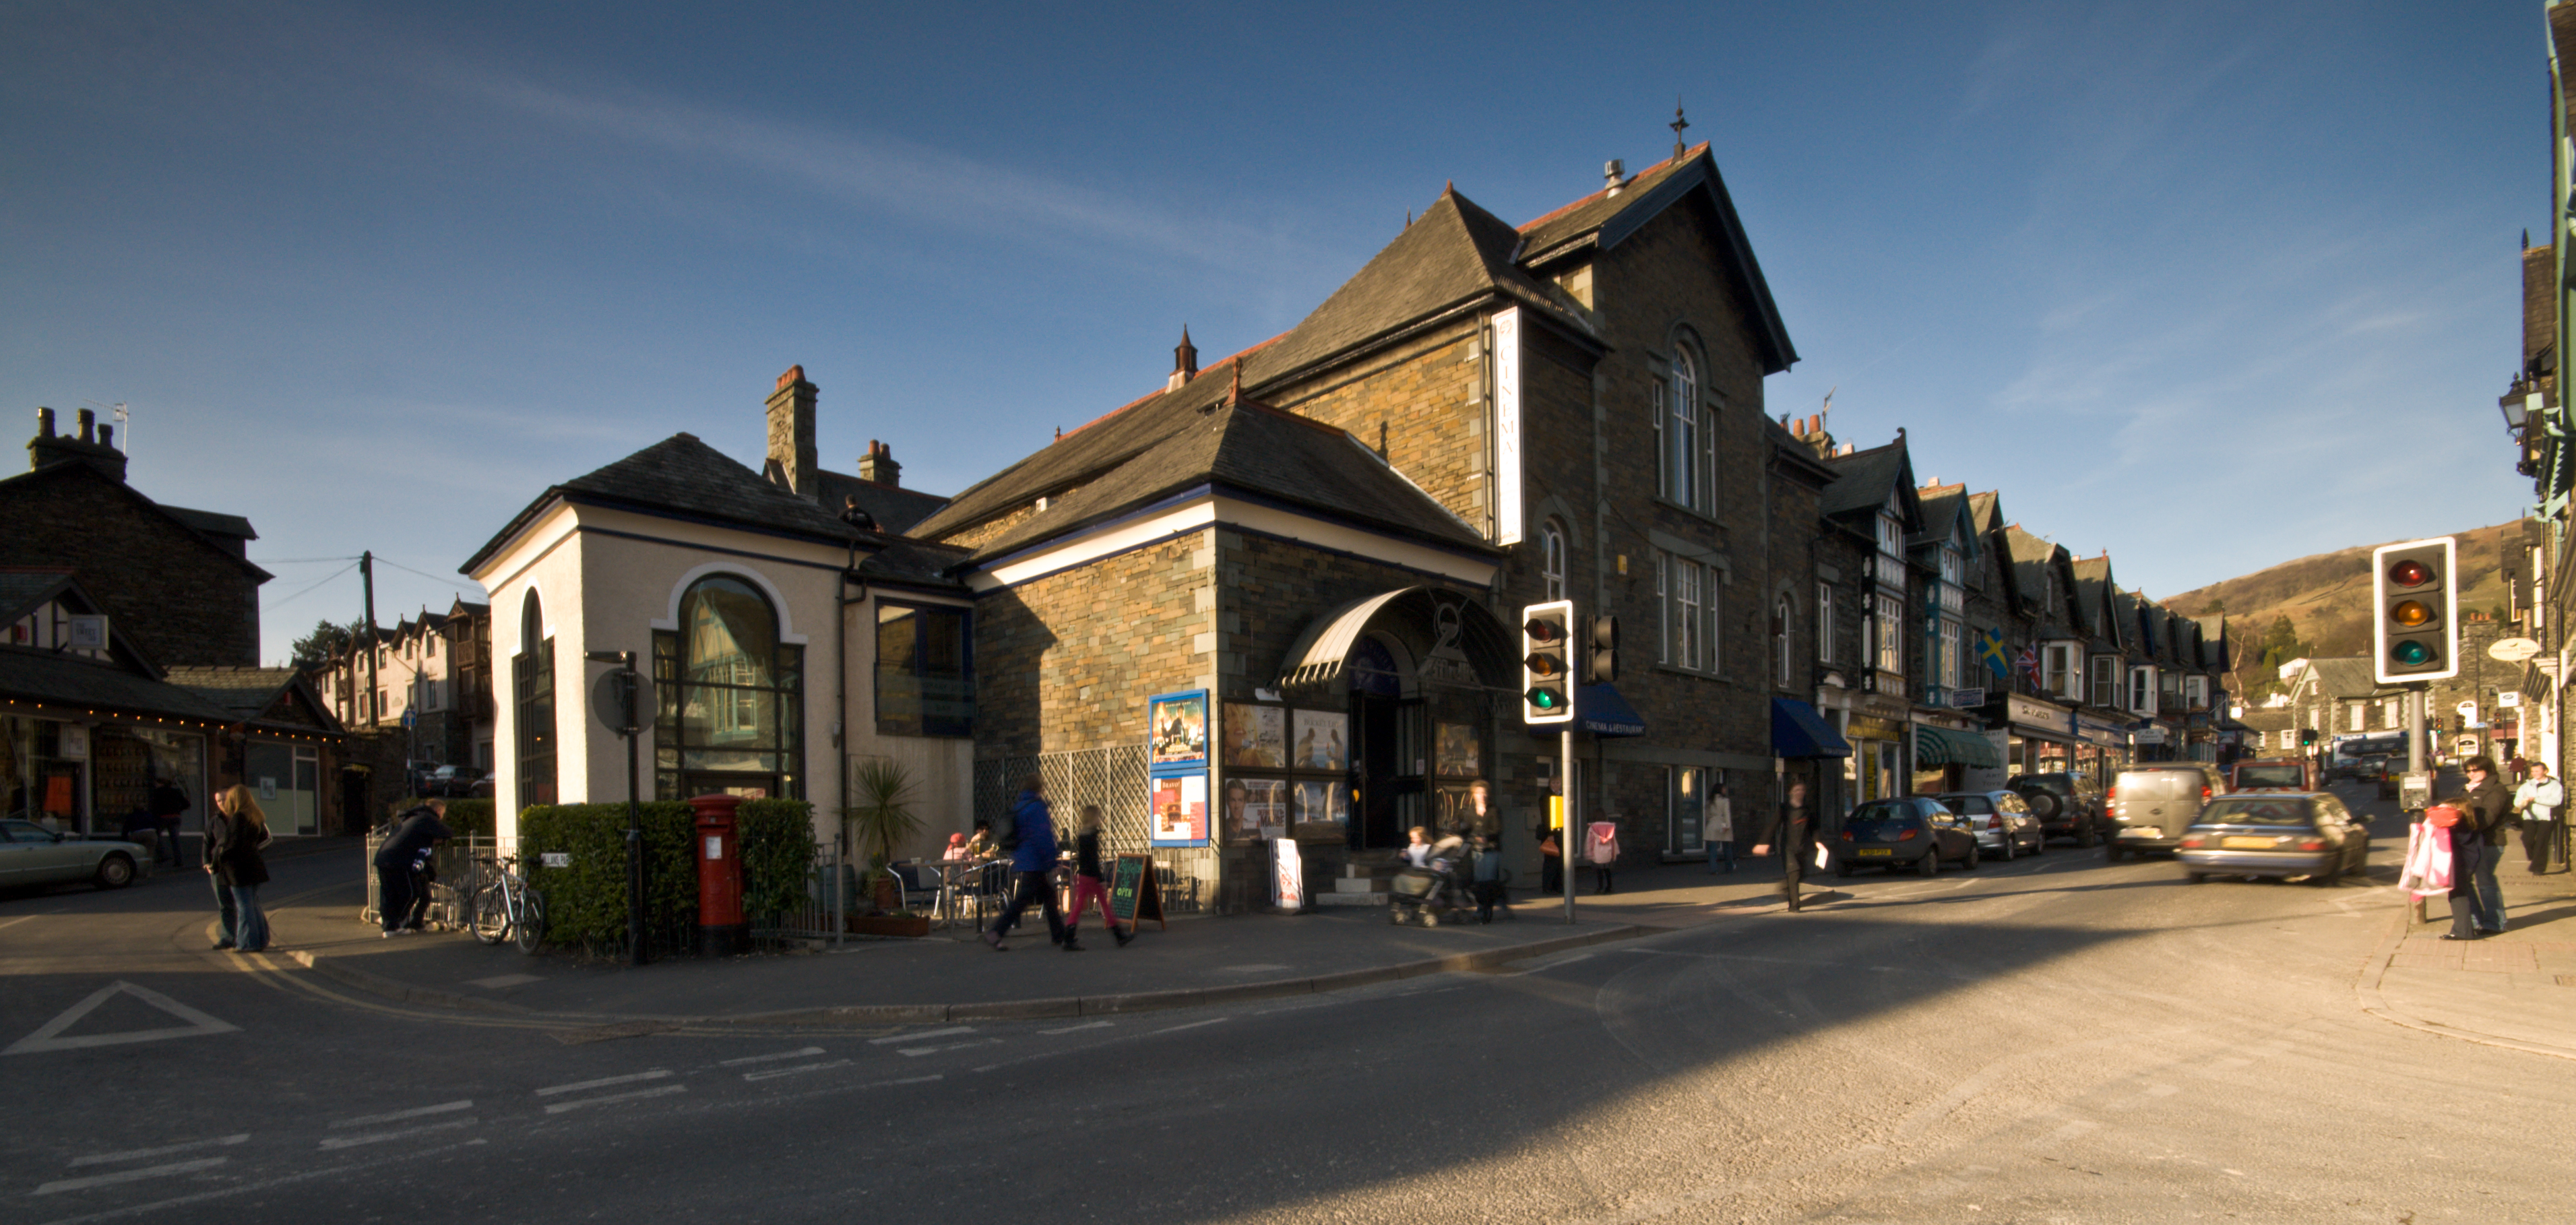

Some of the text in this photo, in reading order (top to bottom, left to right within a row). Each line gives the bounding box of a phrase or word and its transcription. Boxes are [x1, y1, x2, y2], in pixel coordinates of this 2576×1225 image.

[1500, 345, 1515, 456] CINEMA
[1585, 720, 1608, 731] CINEMA
[1274, 841, 1293, 849] CNEMA
[1117, 887, 1133, 898] OPEN
